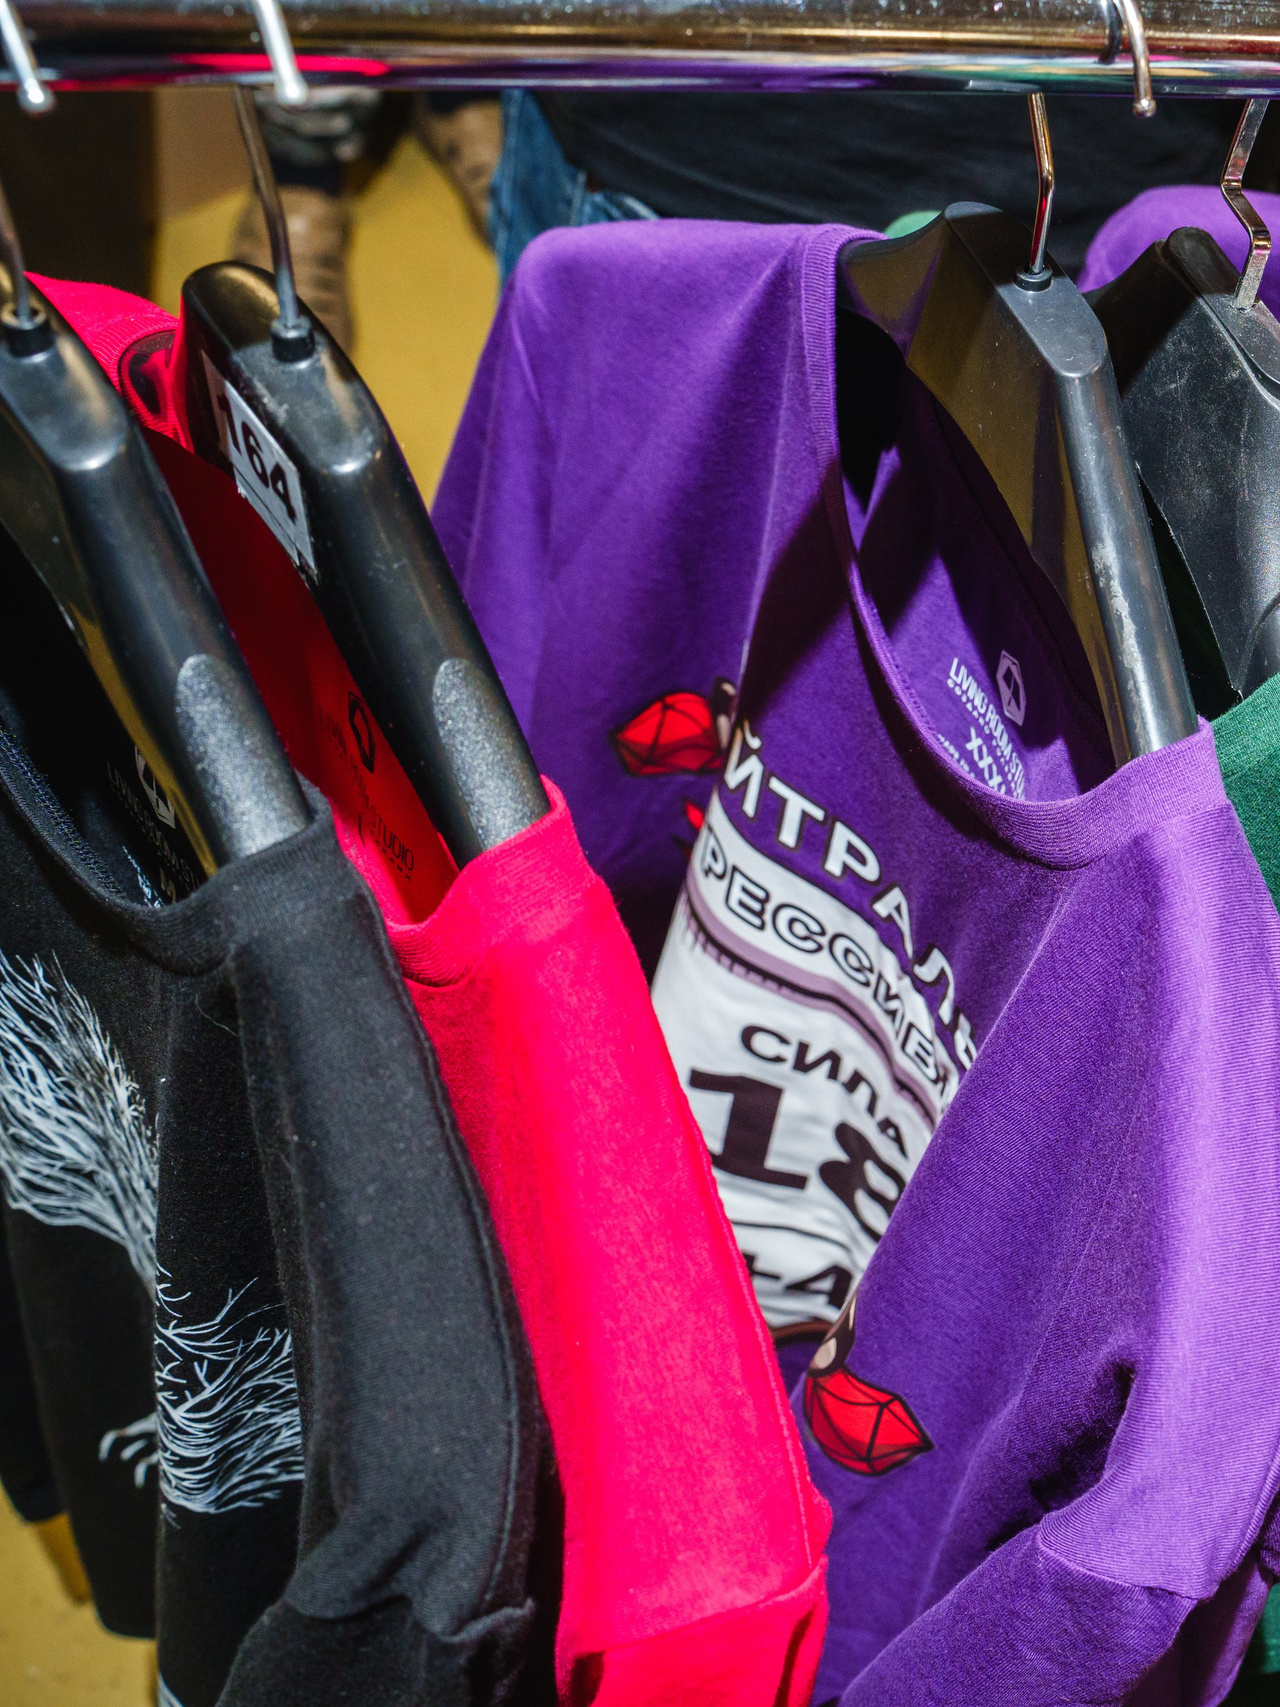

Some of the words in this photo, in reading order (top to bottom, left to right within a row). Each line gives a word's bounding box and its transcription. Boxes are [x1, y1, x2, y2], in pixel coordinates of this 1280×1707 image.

[217, 394, 297, 526] 164
[702, 823, 948, 1098] РЕССИВ
[689, 1068, 907, 1244] 18
[741, 1024, 908, 1160] СИЛА
